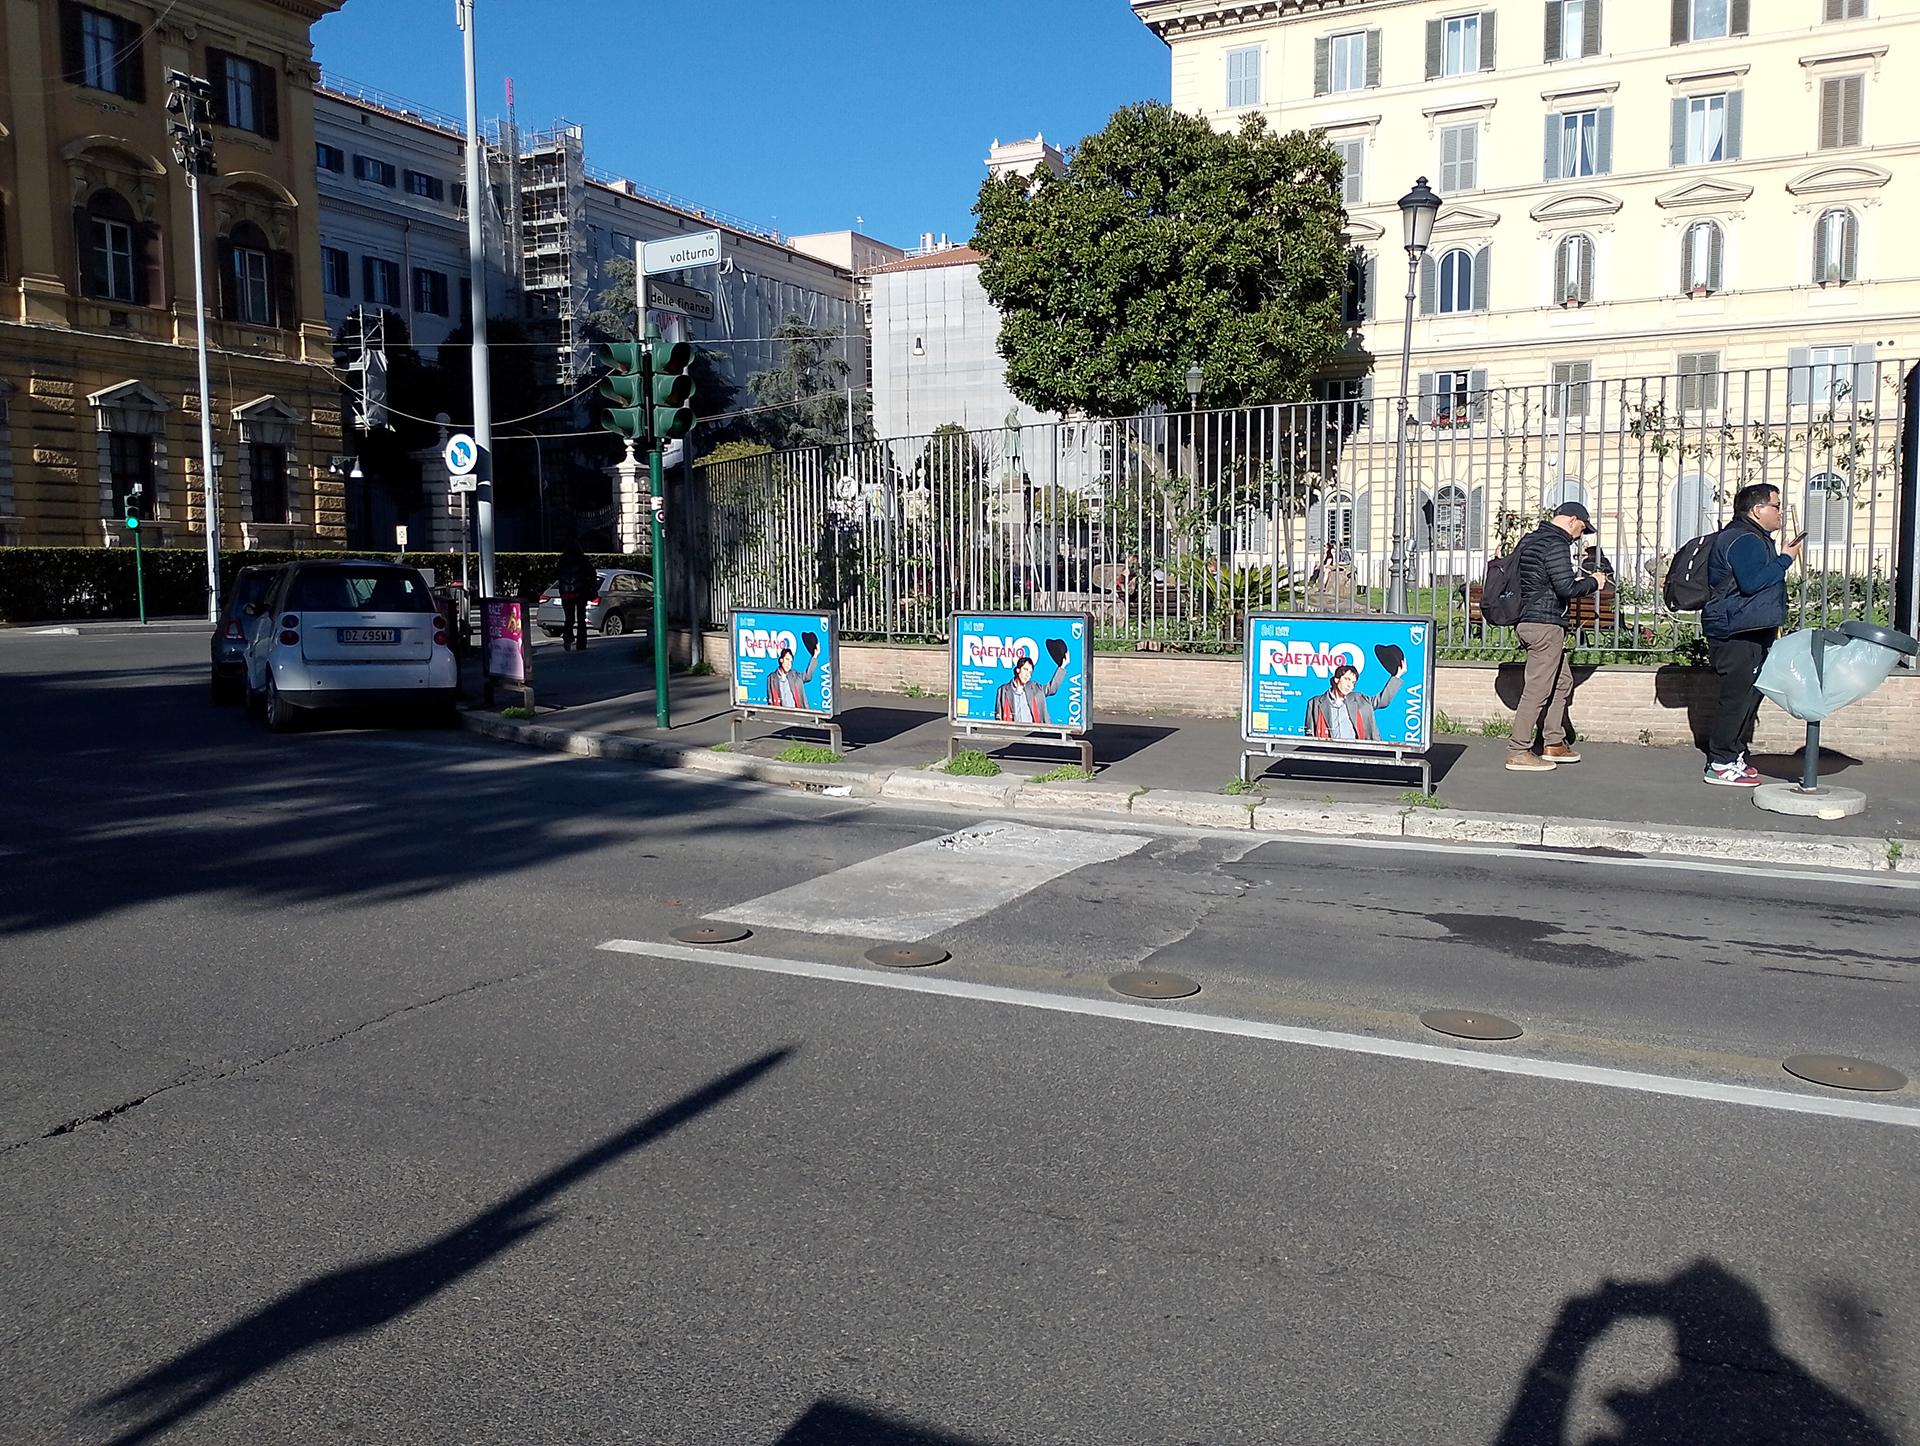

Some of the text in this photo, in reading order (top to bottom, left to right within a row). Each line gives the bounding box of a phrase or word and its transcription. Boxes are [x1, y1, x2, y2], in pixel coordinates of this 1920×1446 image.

[670, 248, 714, 263] volturno
[650, 292, 710, 315] delle finanze
[345, 630, 393, 641] DZ 495WY
[738, 628, 797, 659] RINO
[746, 638, 786, 650] GAETANO
[961, 634, 1039, 669] RINO
[972, 645, 1025, 660] GAETANO
[1259, 640, 1365, 678] RINO
[1272, 652, 1348, 667] GAETANO
[820, 662, 832, 709] ROMA
[1068, 674, 1082, 726] ROMA
[1405, 684, 1423, 743] ROMA
